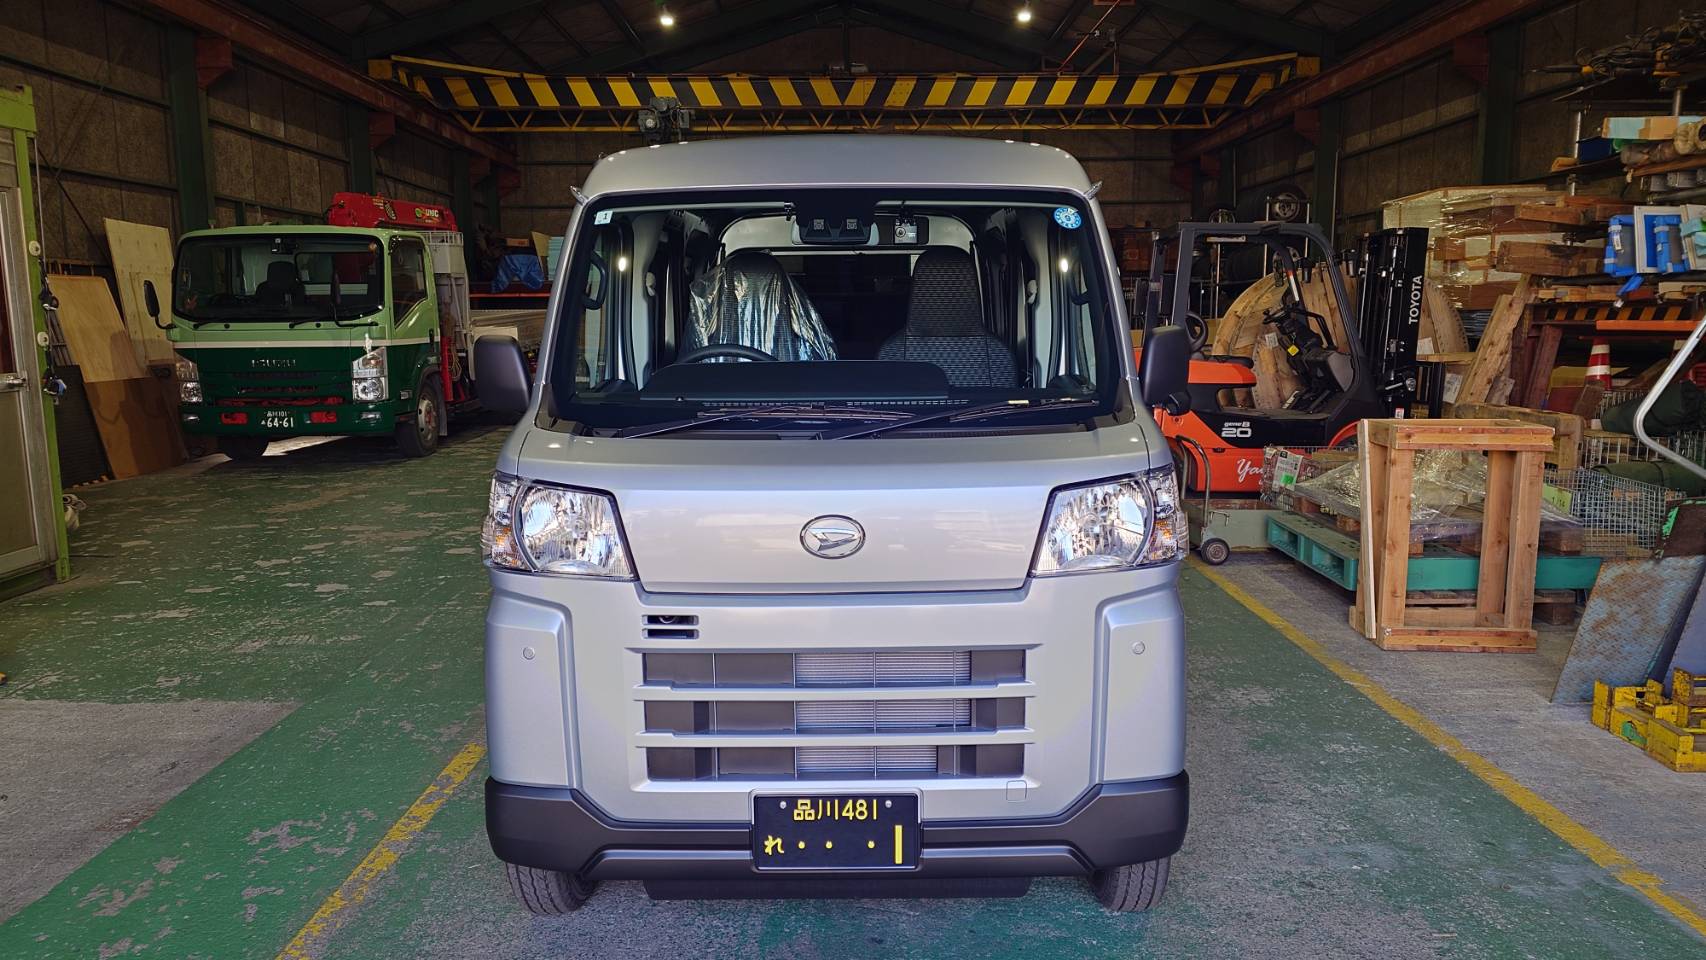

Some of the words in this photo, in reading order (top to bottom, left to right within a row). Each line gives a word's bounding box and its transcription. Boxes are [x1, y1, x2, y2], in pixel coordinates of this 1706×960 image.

[1408, 275, 1423, 325] TOYOTA
[266, 417, 294, 428] 64-61
[1221, 427, 1252, 438] 20
